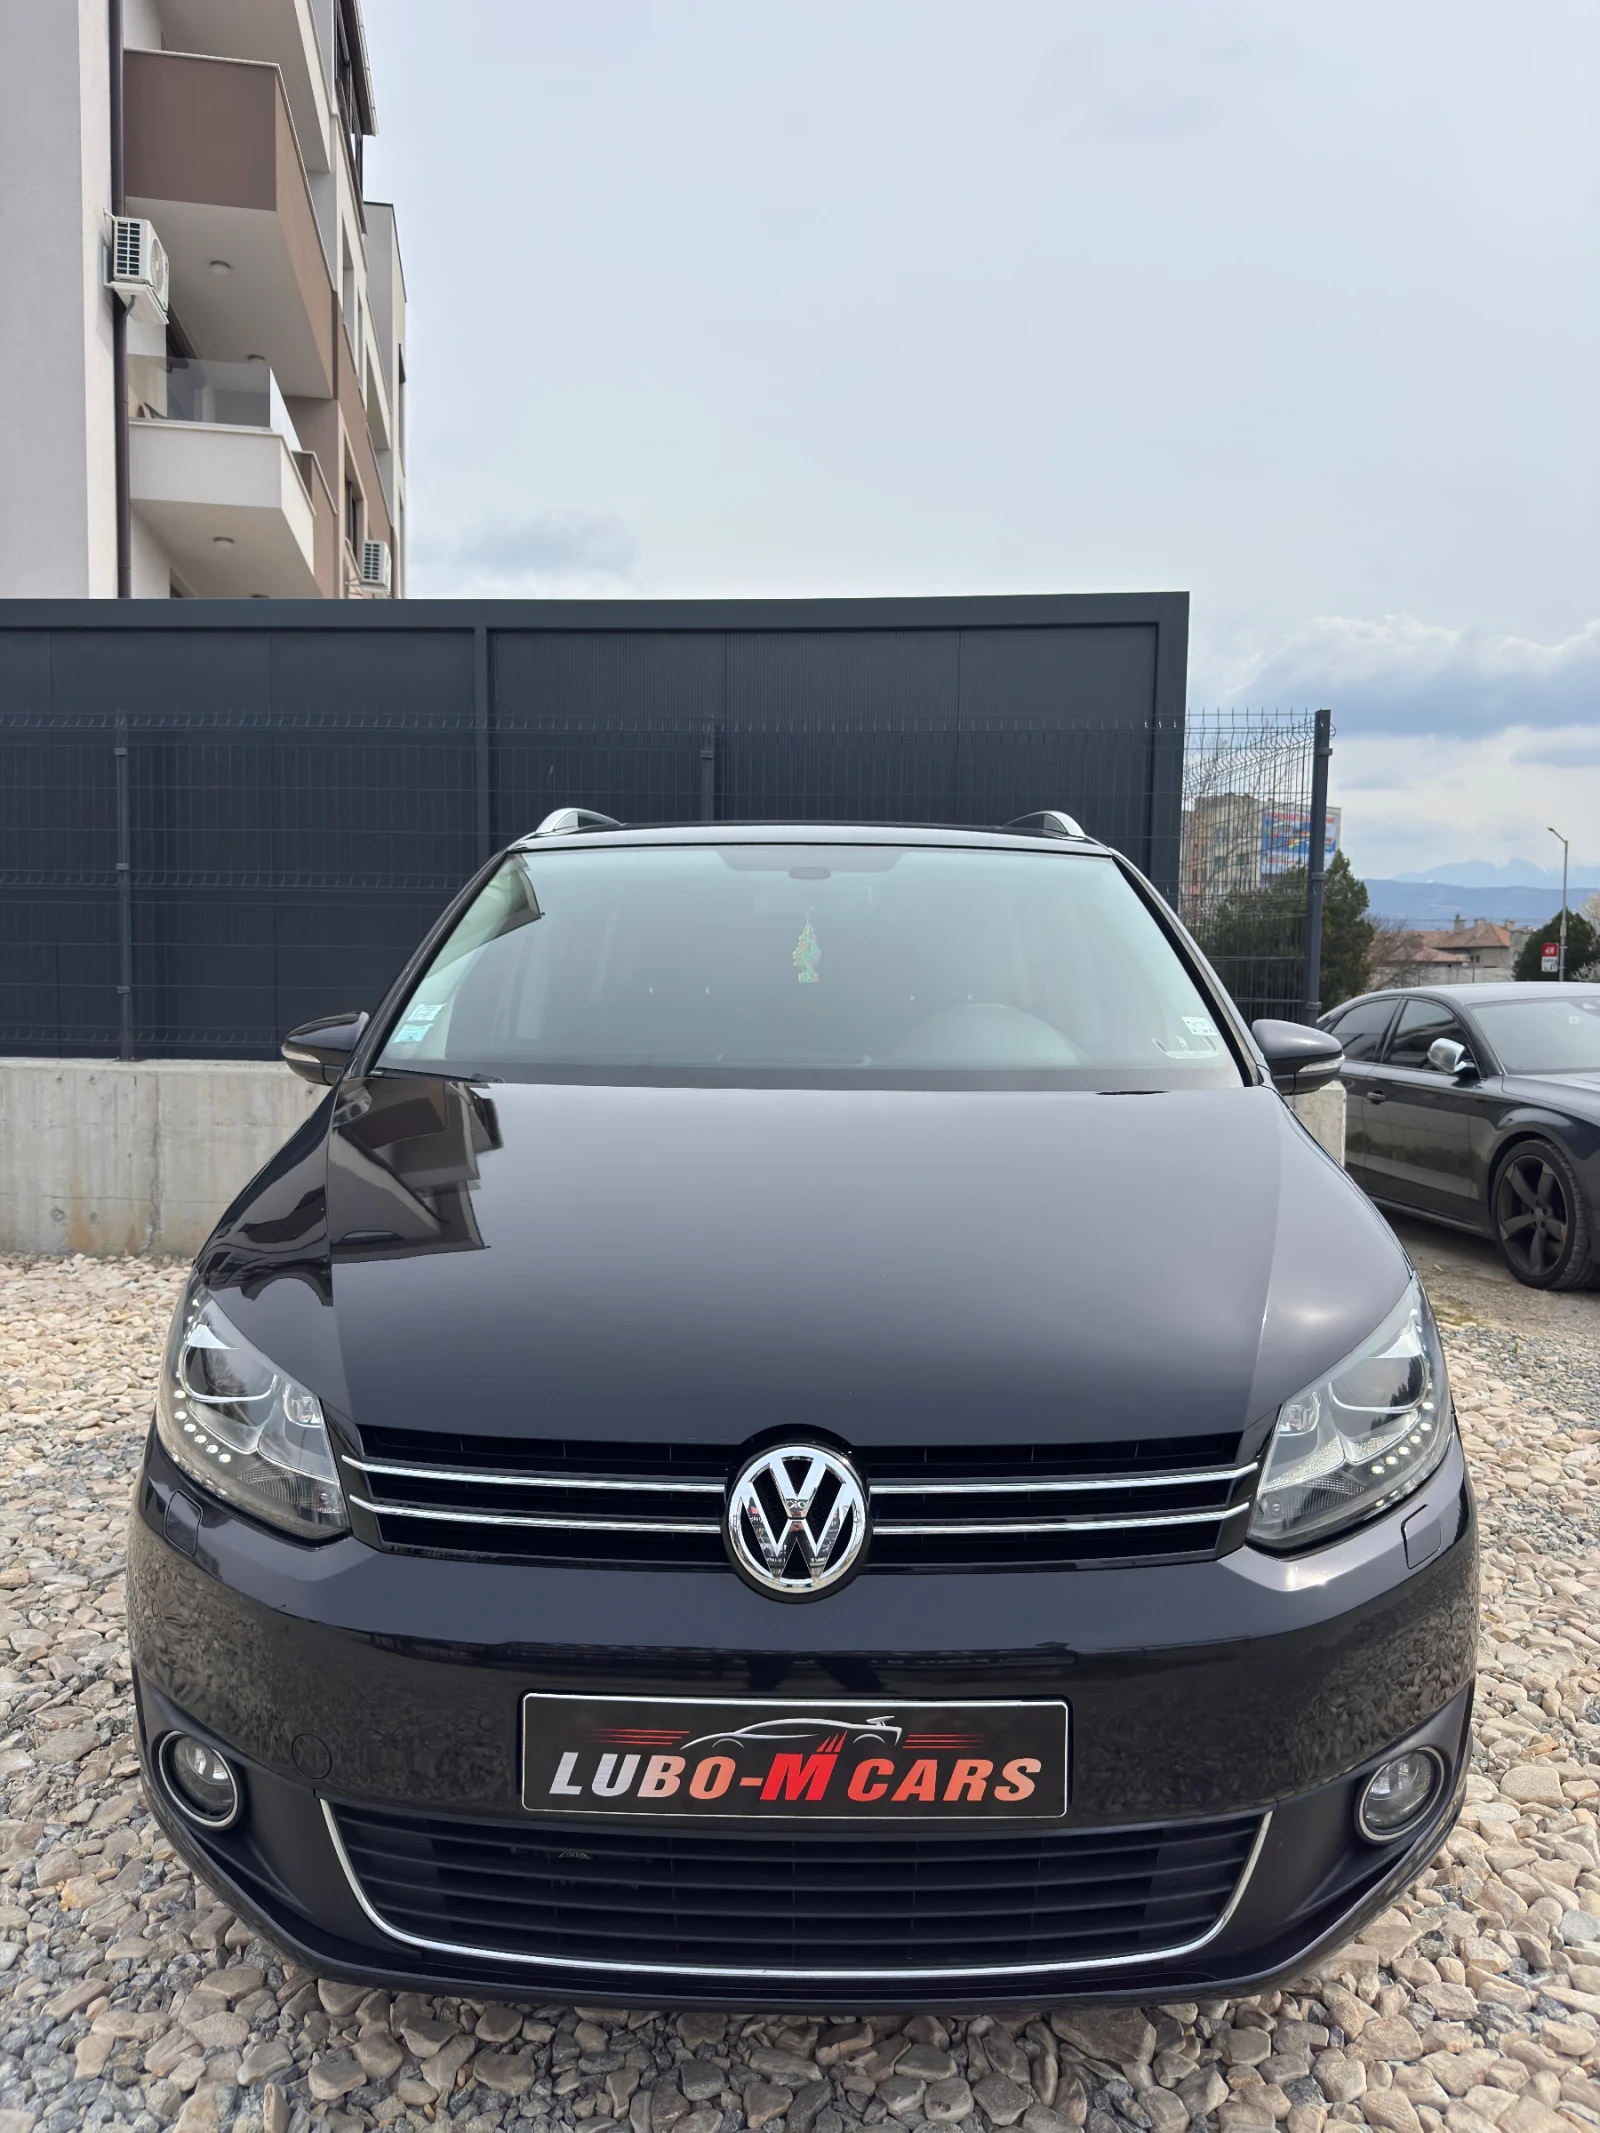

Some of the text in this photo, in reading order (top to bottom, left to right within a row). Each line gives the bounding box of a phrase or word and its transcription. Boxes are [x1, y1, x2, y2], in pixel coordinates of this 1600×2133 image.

[733, 1448, 862, 1588] VW
[549, 1751, 1042, 1802] LUBO-M CARS
